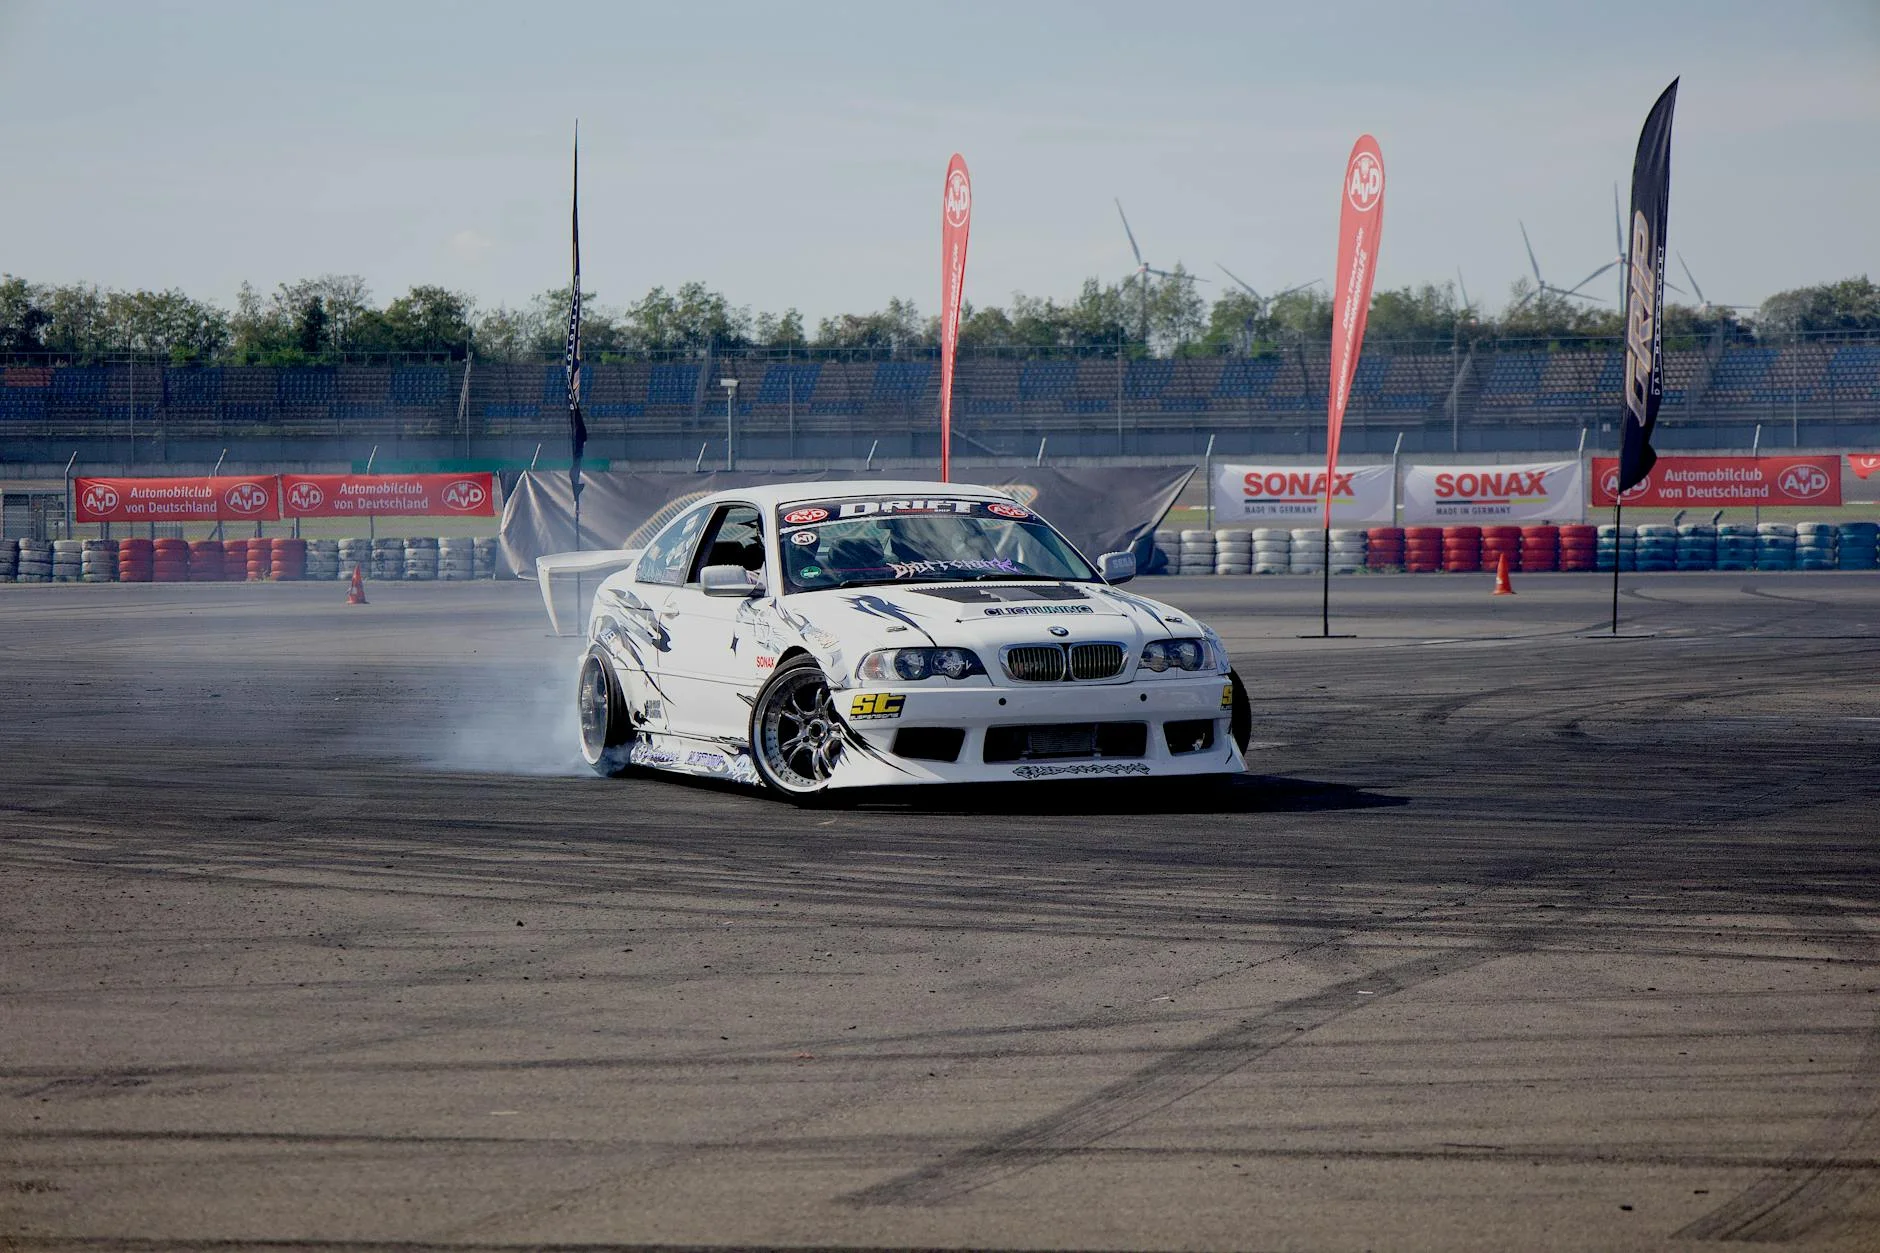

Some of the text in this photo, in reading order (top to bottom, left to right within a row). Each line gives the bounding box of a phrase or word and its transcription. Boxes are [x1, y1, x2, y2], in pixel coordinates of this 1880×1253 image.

[1664, 468, 1763, 482] Automobilclub
[339, 482, 423, 495] Automobilclub
[1243, 472, 1355, 496] SONAX
[1434, 471, 1548, 497] SONAX
[131, 486, 213, 499] Automobilclub
[1658, 485, 1769, 498] von Deutschland
[125, 501, 217, 514] von Deutschland
[334, 496, 429, 510] von Deutschland
[839, 500, 981, 518] DRIFT
[1244, 505, 1318, 514] MADE IN GERMANY
[1436, 506, 1512, 515] MADE IN GERMANY
[756, 656, 775, 669] SONAX
